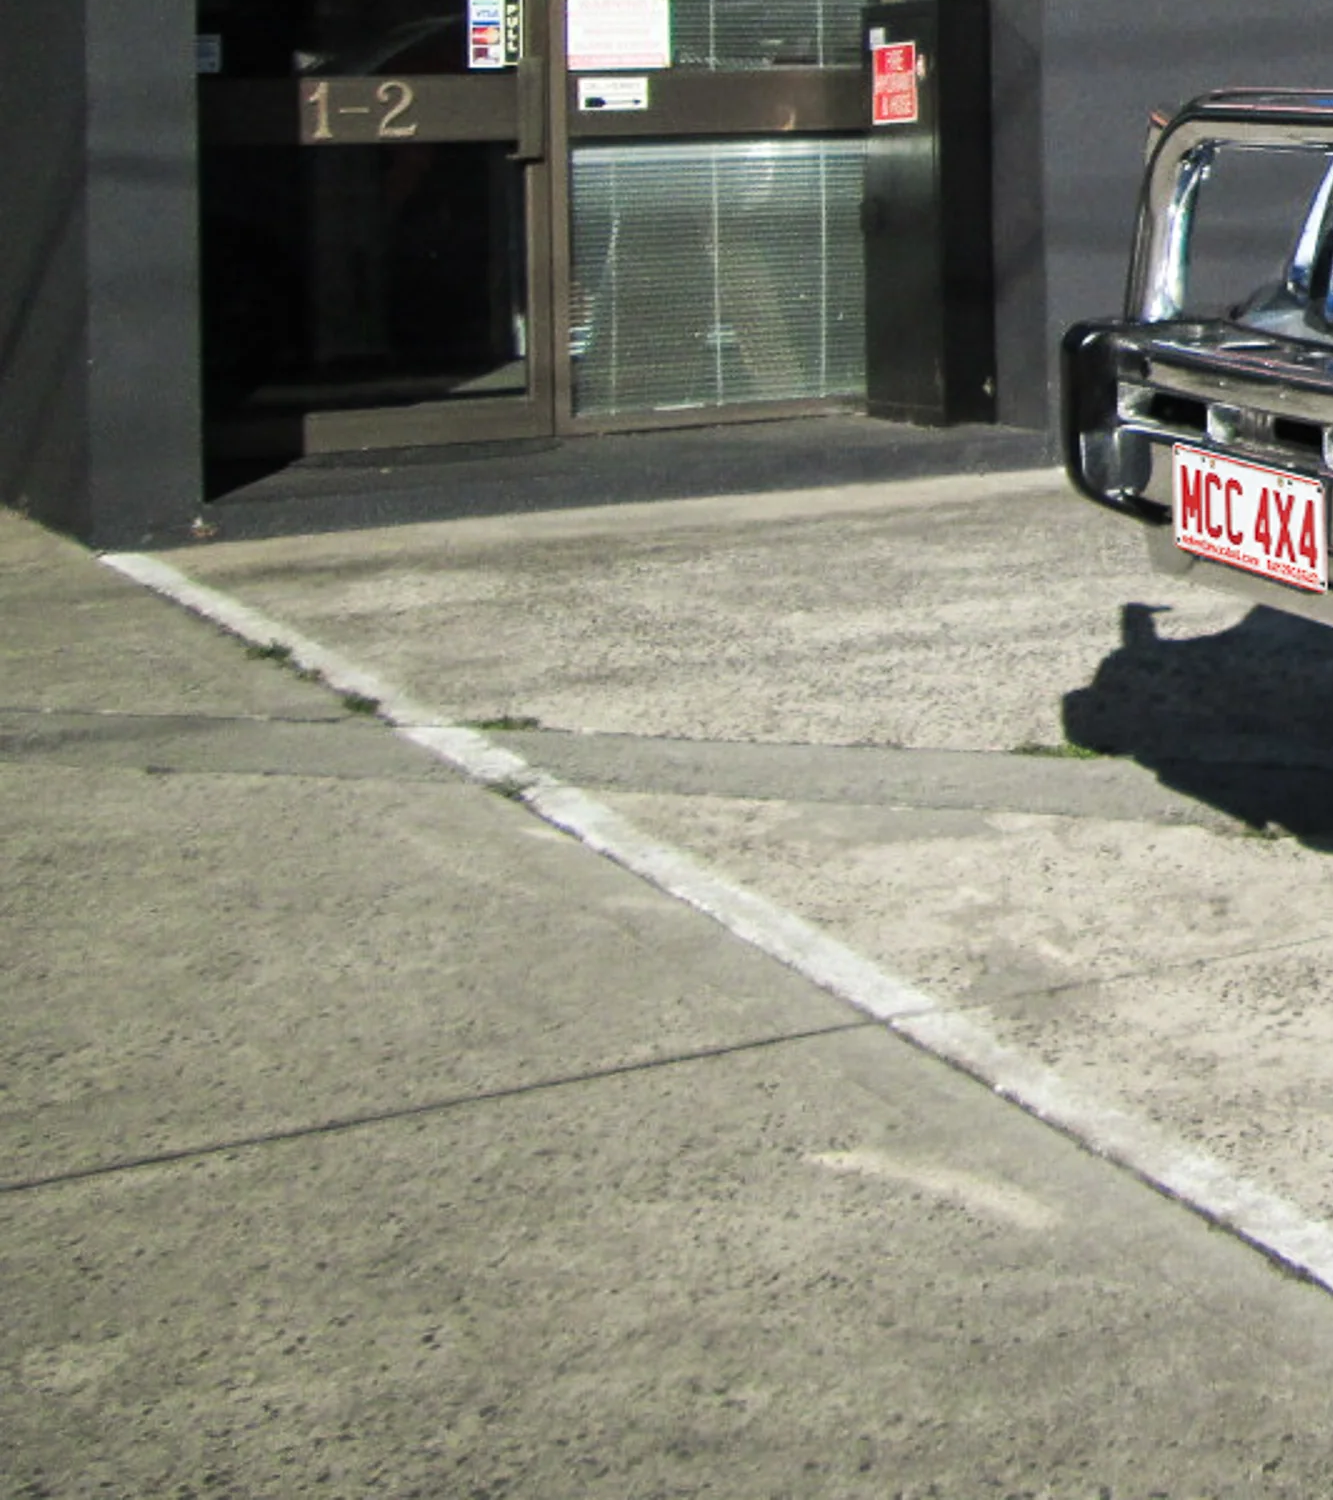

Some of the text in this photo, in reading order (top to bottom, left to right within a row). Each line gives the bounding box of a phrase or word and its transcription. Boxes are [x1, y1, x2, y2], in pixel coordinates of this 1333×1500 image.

[506, 4, 519, 53] PULL
[306, 81, 418, 140] 1-2
[1180, 464, 1318, 569] MCC 4X4
